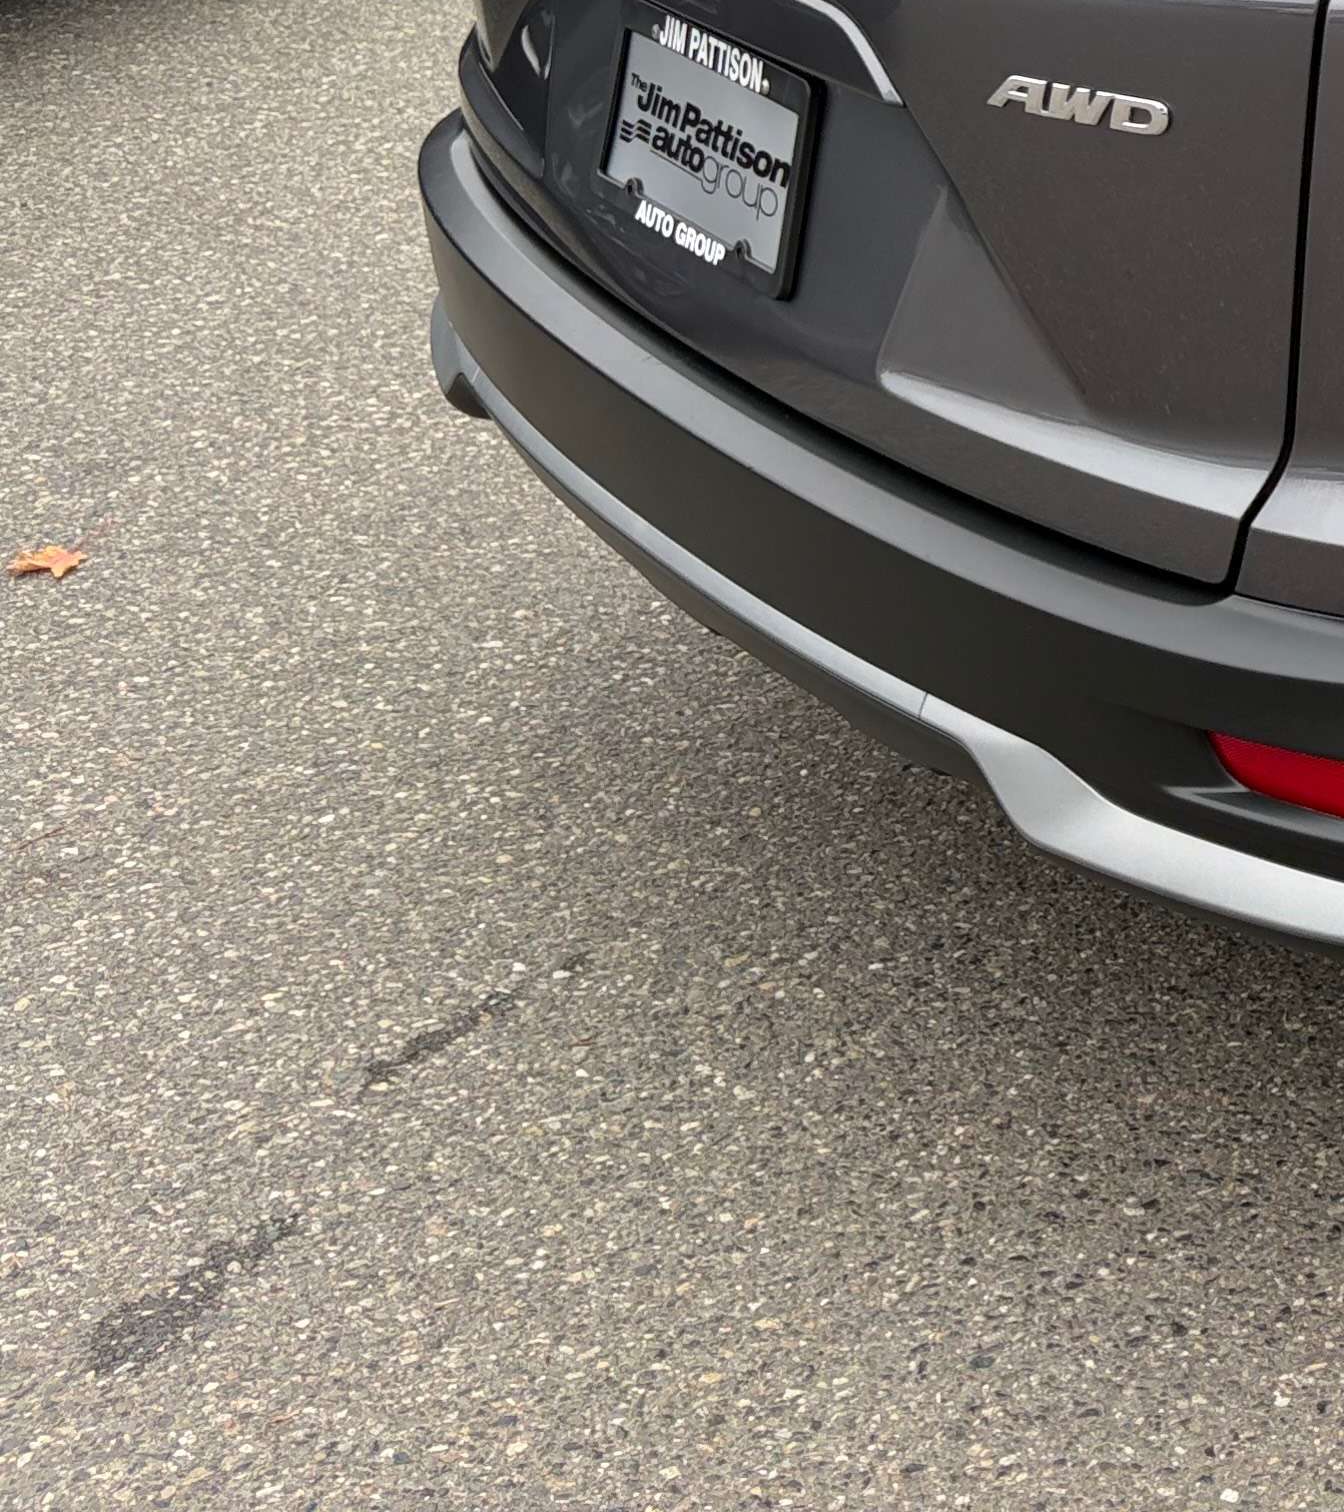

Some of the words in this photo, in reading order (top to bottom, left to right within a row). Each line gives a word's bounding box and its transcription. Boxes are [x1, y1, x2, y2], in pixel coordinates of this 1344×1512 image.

[659, 14, 688, 54] JIM
[688, 26, 764, 92] PATTISON
[986, 74, 1169, 136] AWD
[634, 200, 674, 238] AUTO
[675, 221, 726, 266] GROUP
